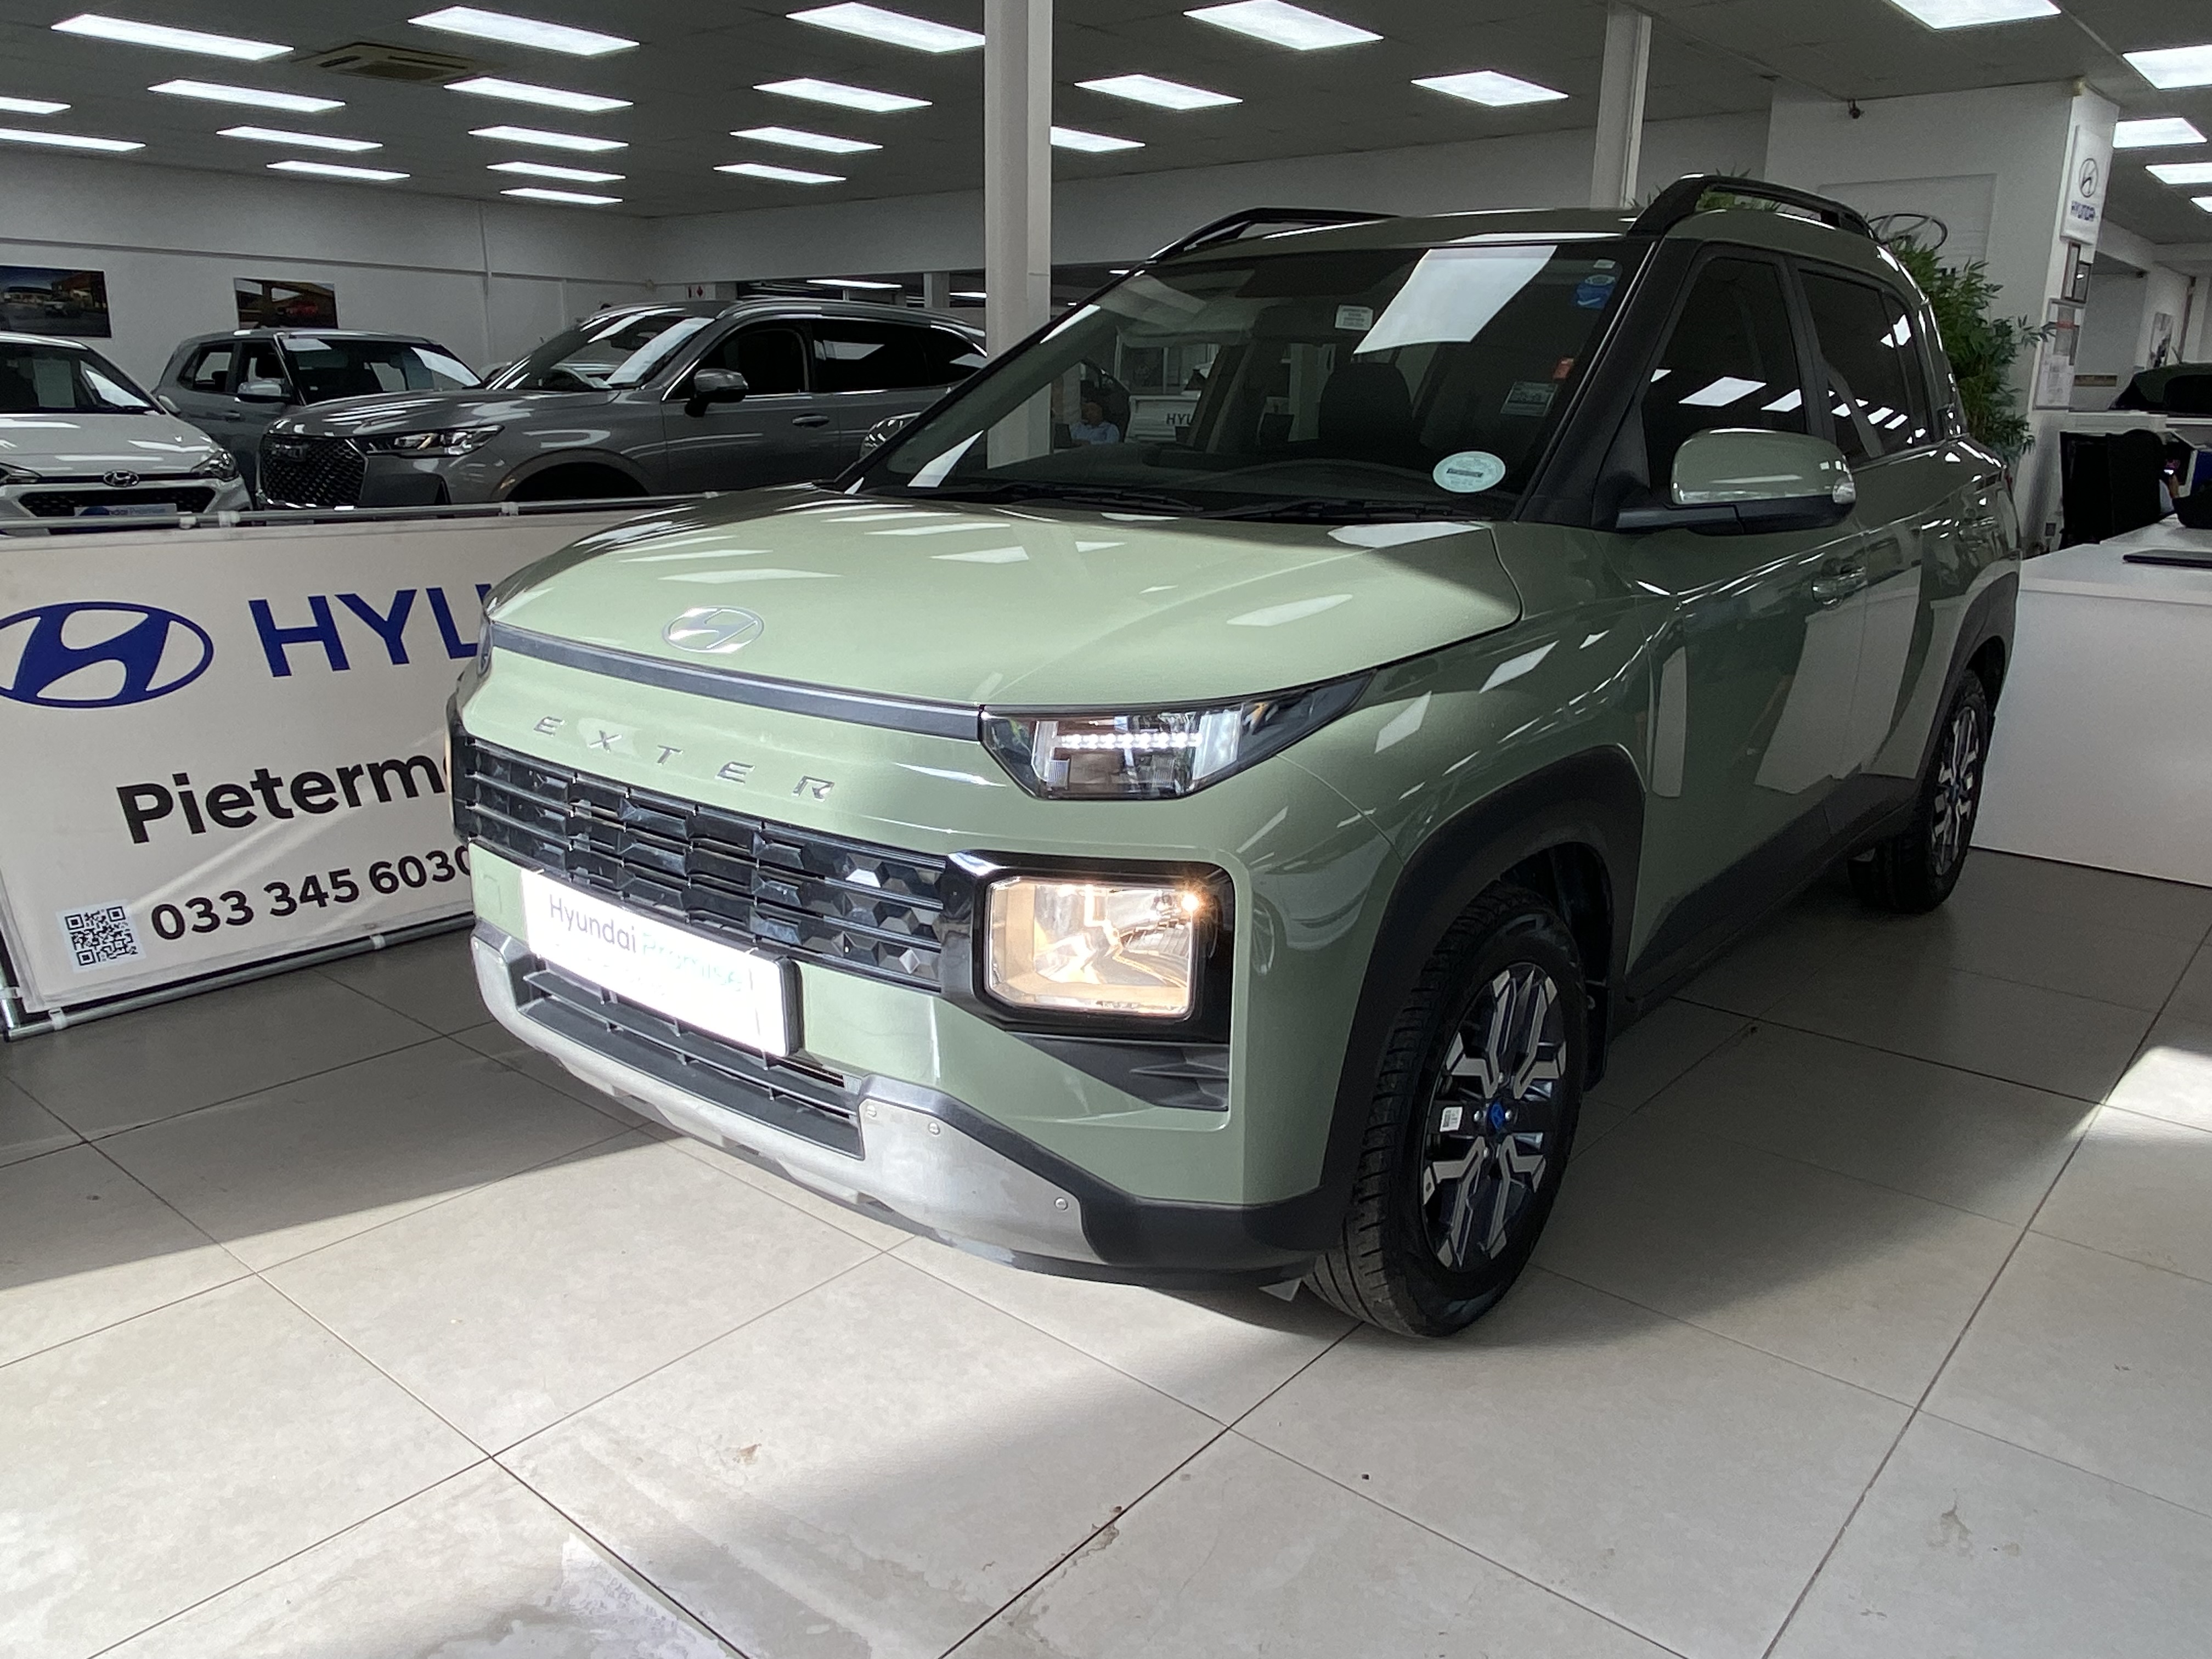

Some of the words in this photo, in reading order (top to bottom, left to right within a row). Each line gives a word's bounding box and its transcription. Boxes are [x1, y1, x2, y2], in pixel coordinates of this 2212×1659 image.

[534, 715, 835, 802] EXTER
[116, 755, 447, 844] Pieterm
[151, 890, 255, 940] 033
[263, 867, 359, 917] 345
[549, 894, 636, 953] Hyundai
